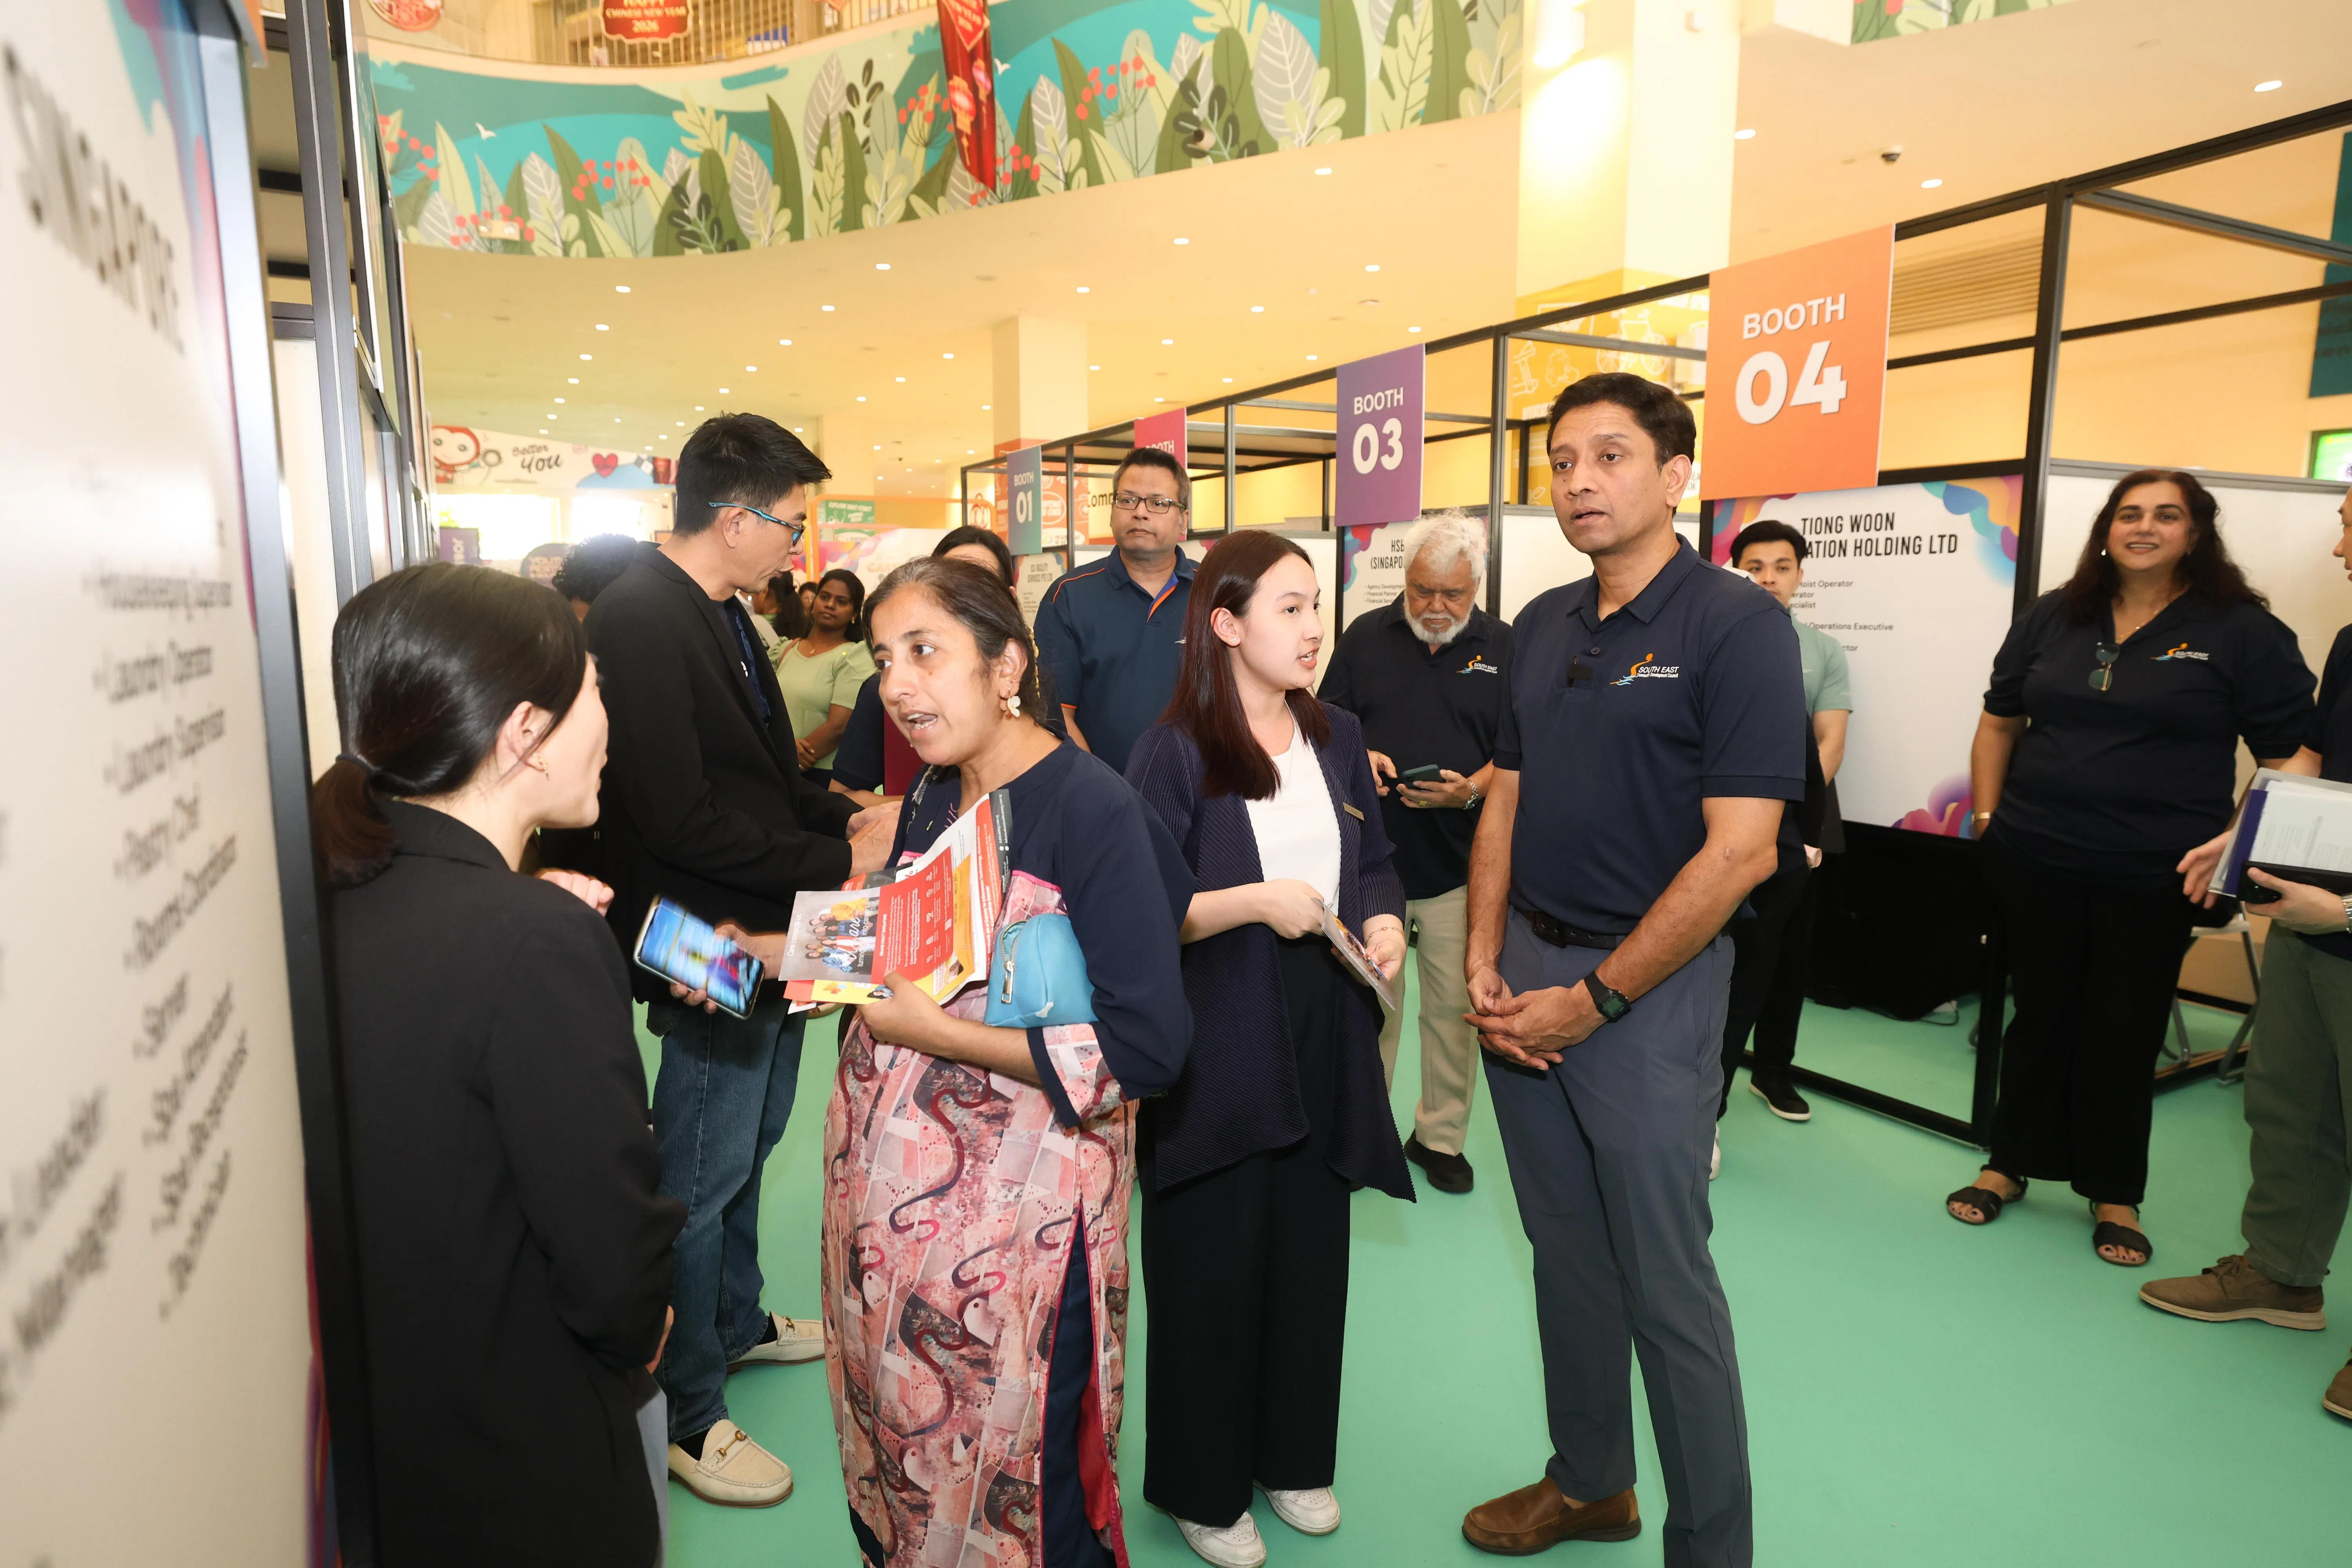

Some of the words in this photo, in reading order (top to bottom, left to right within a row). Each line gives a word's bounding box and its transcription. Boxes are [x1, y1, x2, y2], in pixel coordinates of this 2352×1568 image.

[1743, 293, 1846, 339] BOOTH
[1735, 340, 1847, 425] 04
[1354, 387, 1404, 416] BOOTH
[1353, 417, 1403, 474] 03
[1014, 471, 1034, 486] BOOTH
[1016, 490, 1033, 524] 01
[1801, 515, 1844, 535] TIONG
[1850, 512, 1895, 533] WOON
[1853, 535, 1922, 557] HOLDING
[1929, 534, 1958, 554] LTD
[1371, 555, 1405, 570] (SINGAPO
[1818, 580, 1854, 588] Operator
[1809, 622, 1852, 630] Operations
[1853, 622, 1895, 631] Executive
[786, 943, 796, 956] Care
